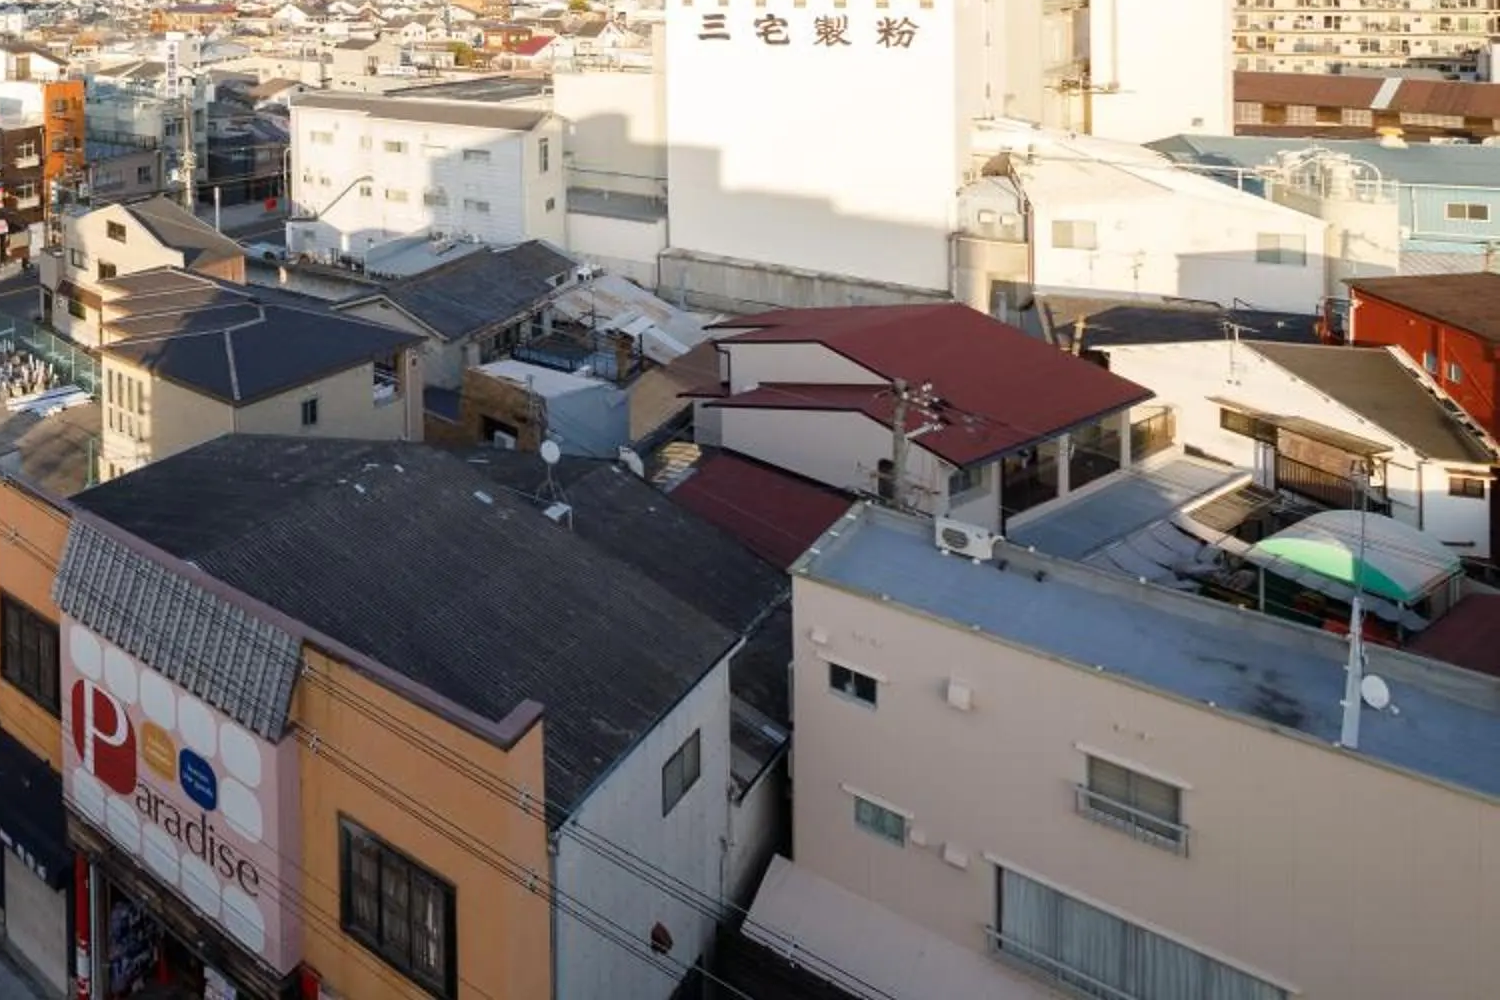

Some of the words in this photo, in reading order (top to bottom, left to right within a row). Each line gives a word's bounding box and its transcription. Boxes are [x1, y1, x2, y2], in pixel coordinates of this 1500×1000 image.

[698, 13, 919, 48] 三宅製粉
[81, 680, 260, 897] Paradise
